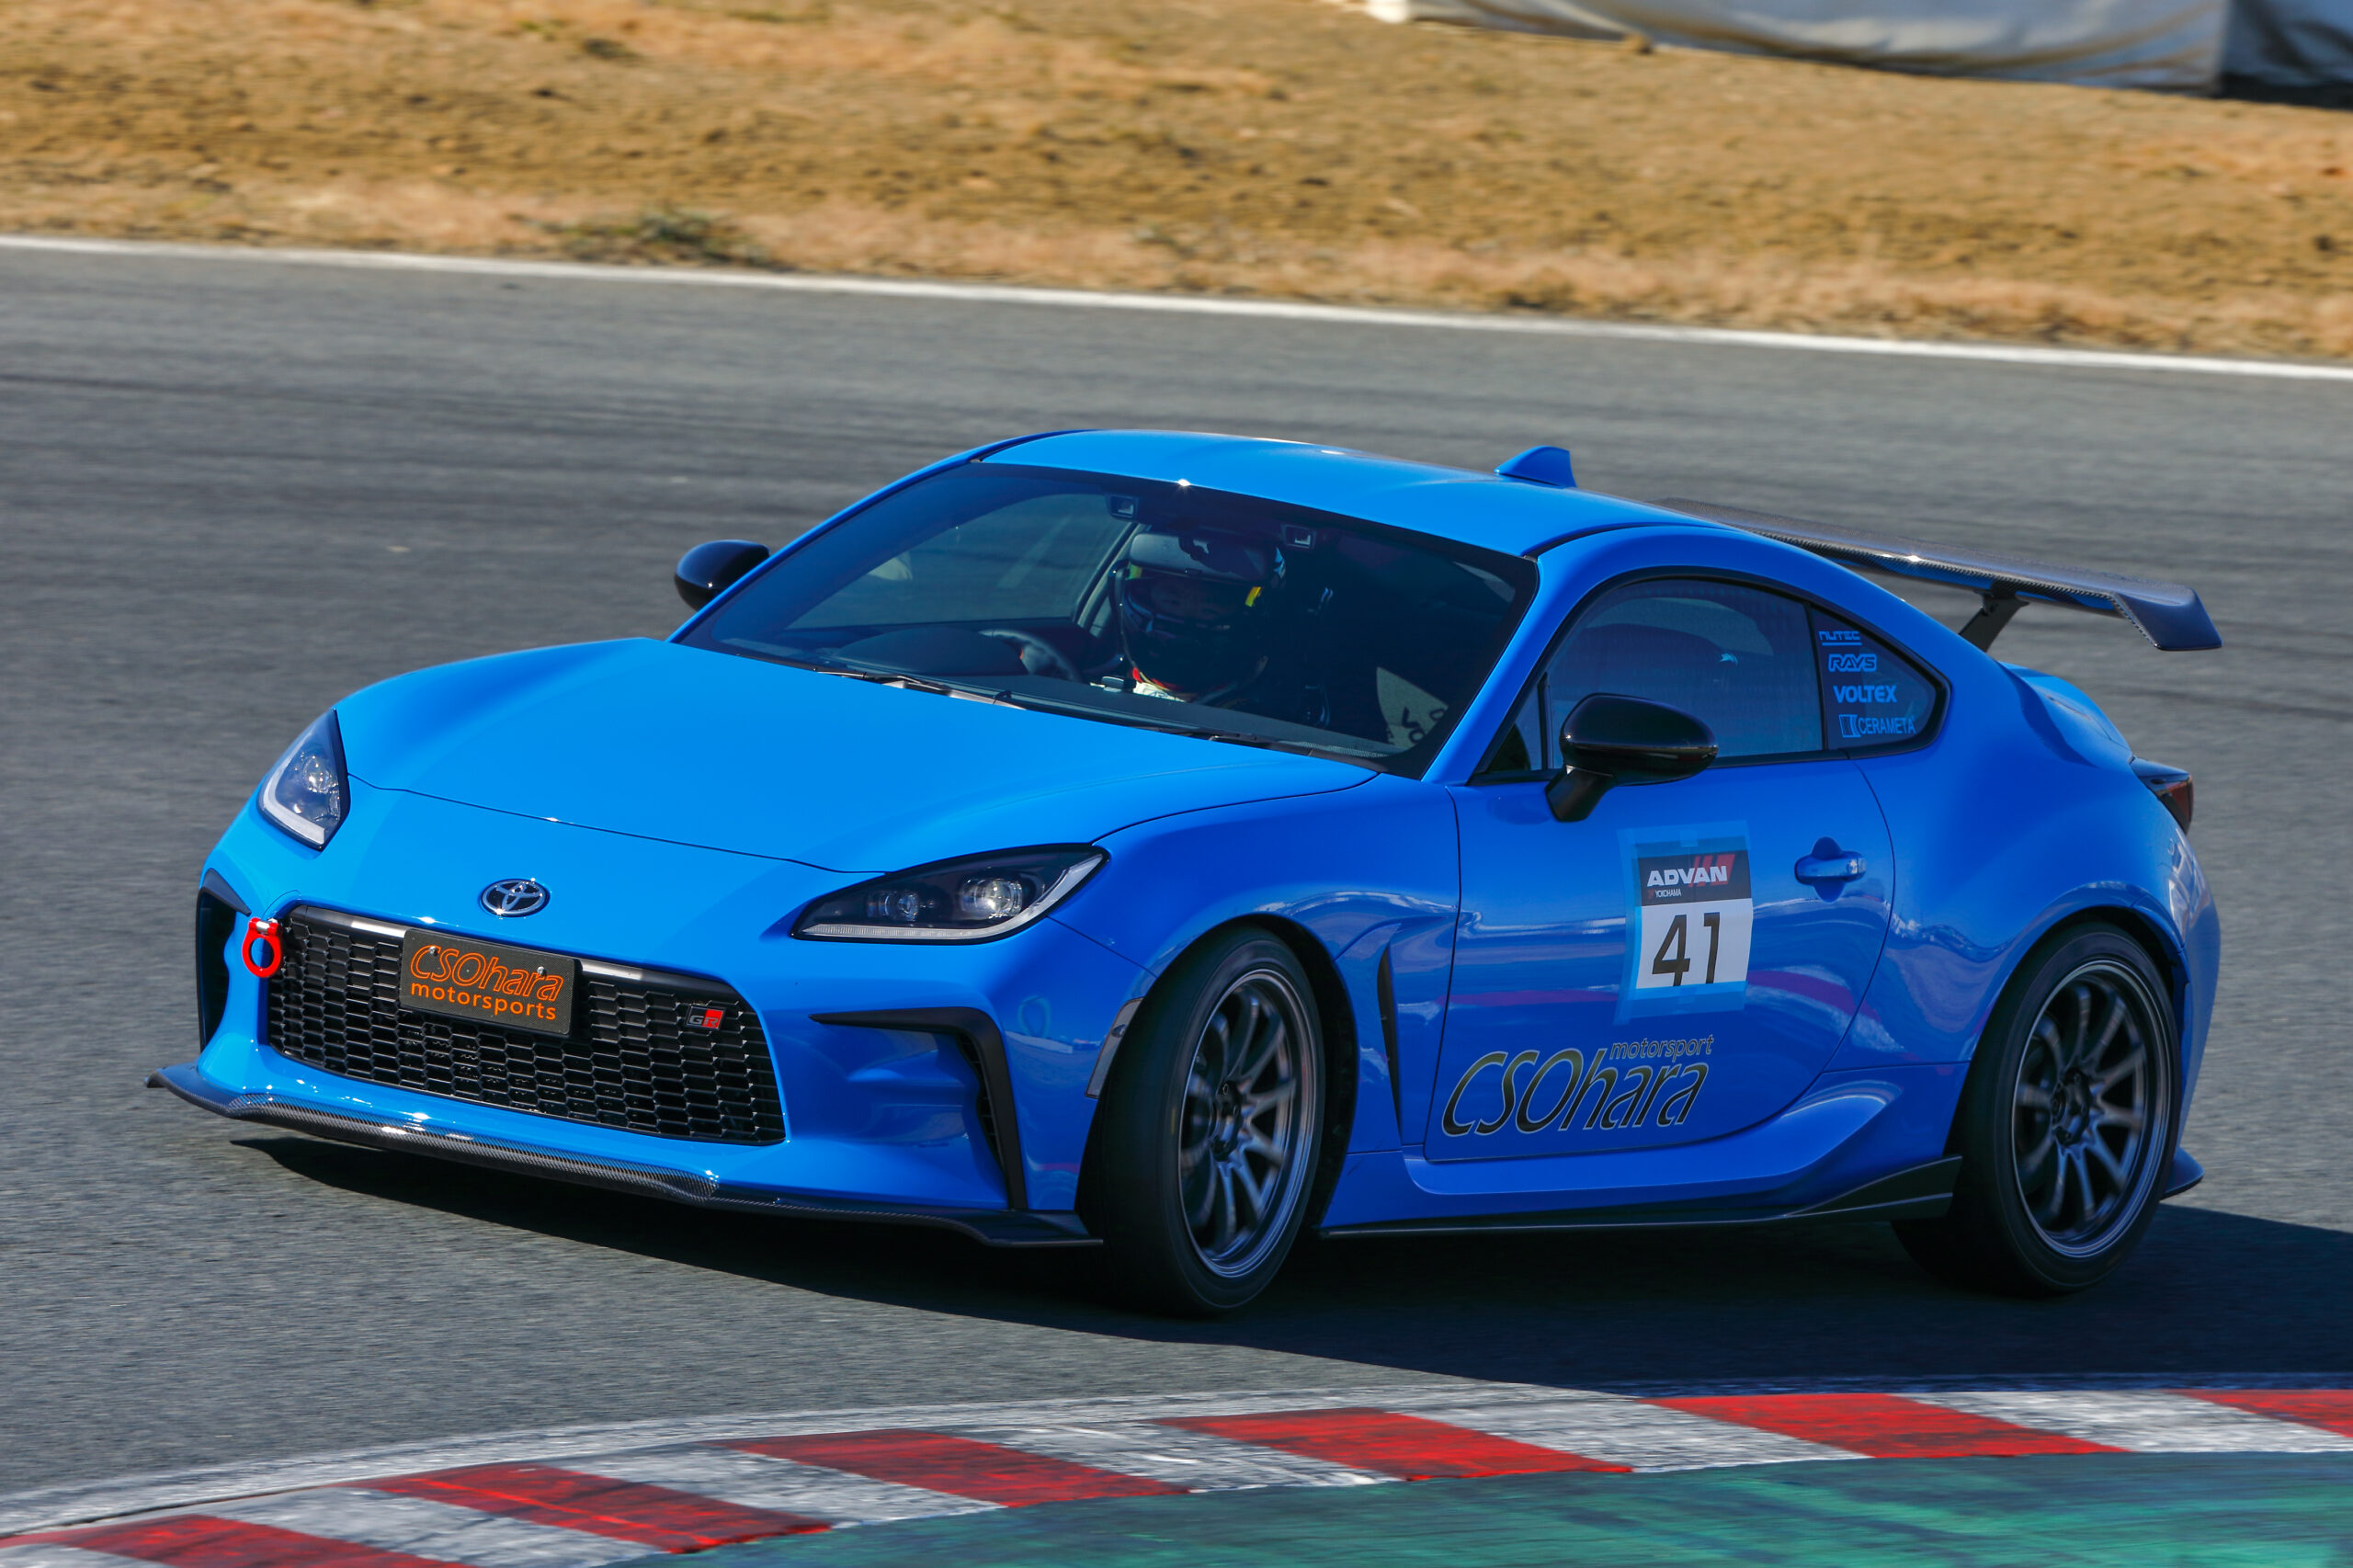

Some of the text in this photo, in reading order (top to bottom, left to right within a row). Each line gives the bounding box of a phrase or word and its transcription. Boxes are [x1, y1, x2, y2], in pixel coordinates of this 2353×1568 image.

[1828, 653, 1877, 672] RAYS
[1833, 685, 1898, 703] VOLTEX
[1646, 865, 1729, 887] ADVAN
[1651, 911, 1721, 986] 41
[410, 945, 564, 1003] CSOhara
[410, 982, 557, 1021] motorsports
[688, 1015, 719, 1027] GR
[1608, 1034, 1714, 1062] motorsport
[1441, 1048, 1710, 1137] CSOhara
